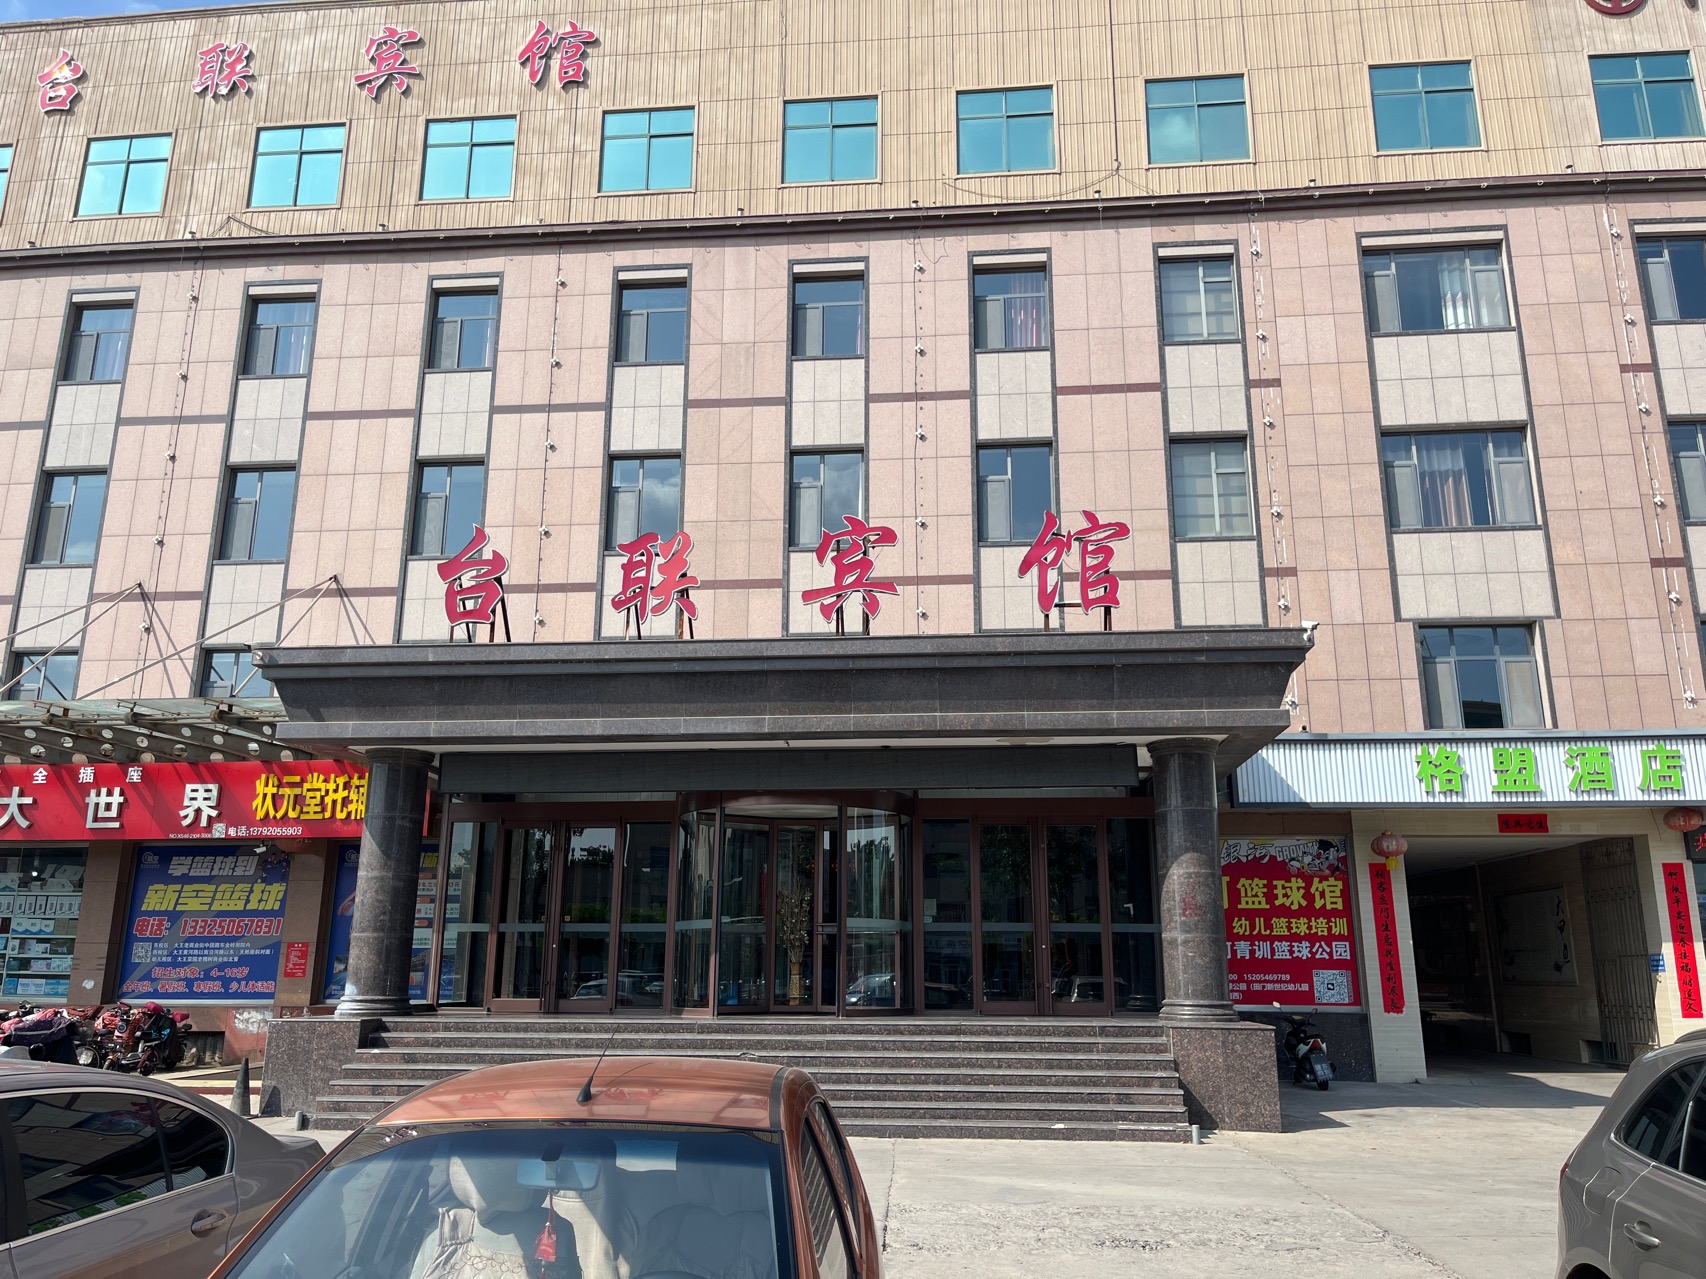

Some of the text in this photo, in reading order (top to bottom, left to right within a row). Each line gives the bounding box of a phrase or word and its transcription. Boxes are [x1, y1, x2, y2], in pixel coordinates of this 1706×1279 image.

[37, 19, 598, 113] 台联宾馆
[437, 509, 1132, 627] 台联宾馆
[0, 766, 143, 785] 全插座
[1415, 743, 1684, 793] 格盟酒店
[0, 783, 220, 829] 大世界
[1221, 840, 1274, 864] 银河
[168, 854, 260, 877] 学篮球到
[1232, 917, 1348, 936] 幼儿篮球培训
[1243, 973, 1291, 981] 15205469789
